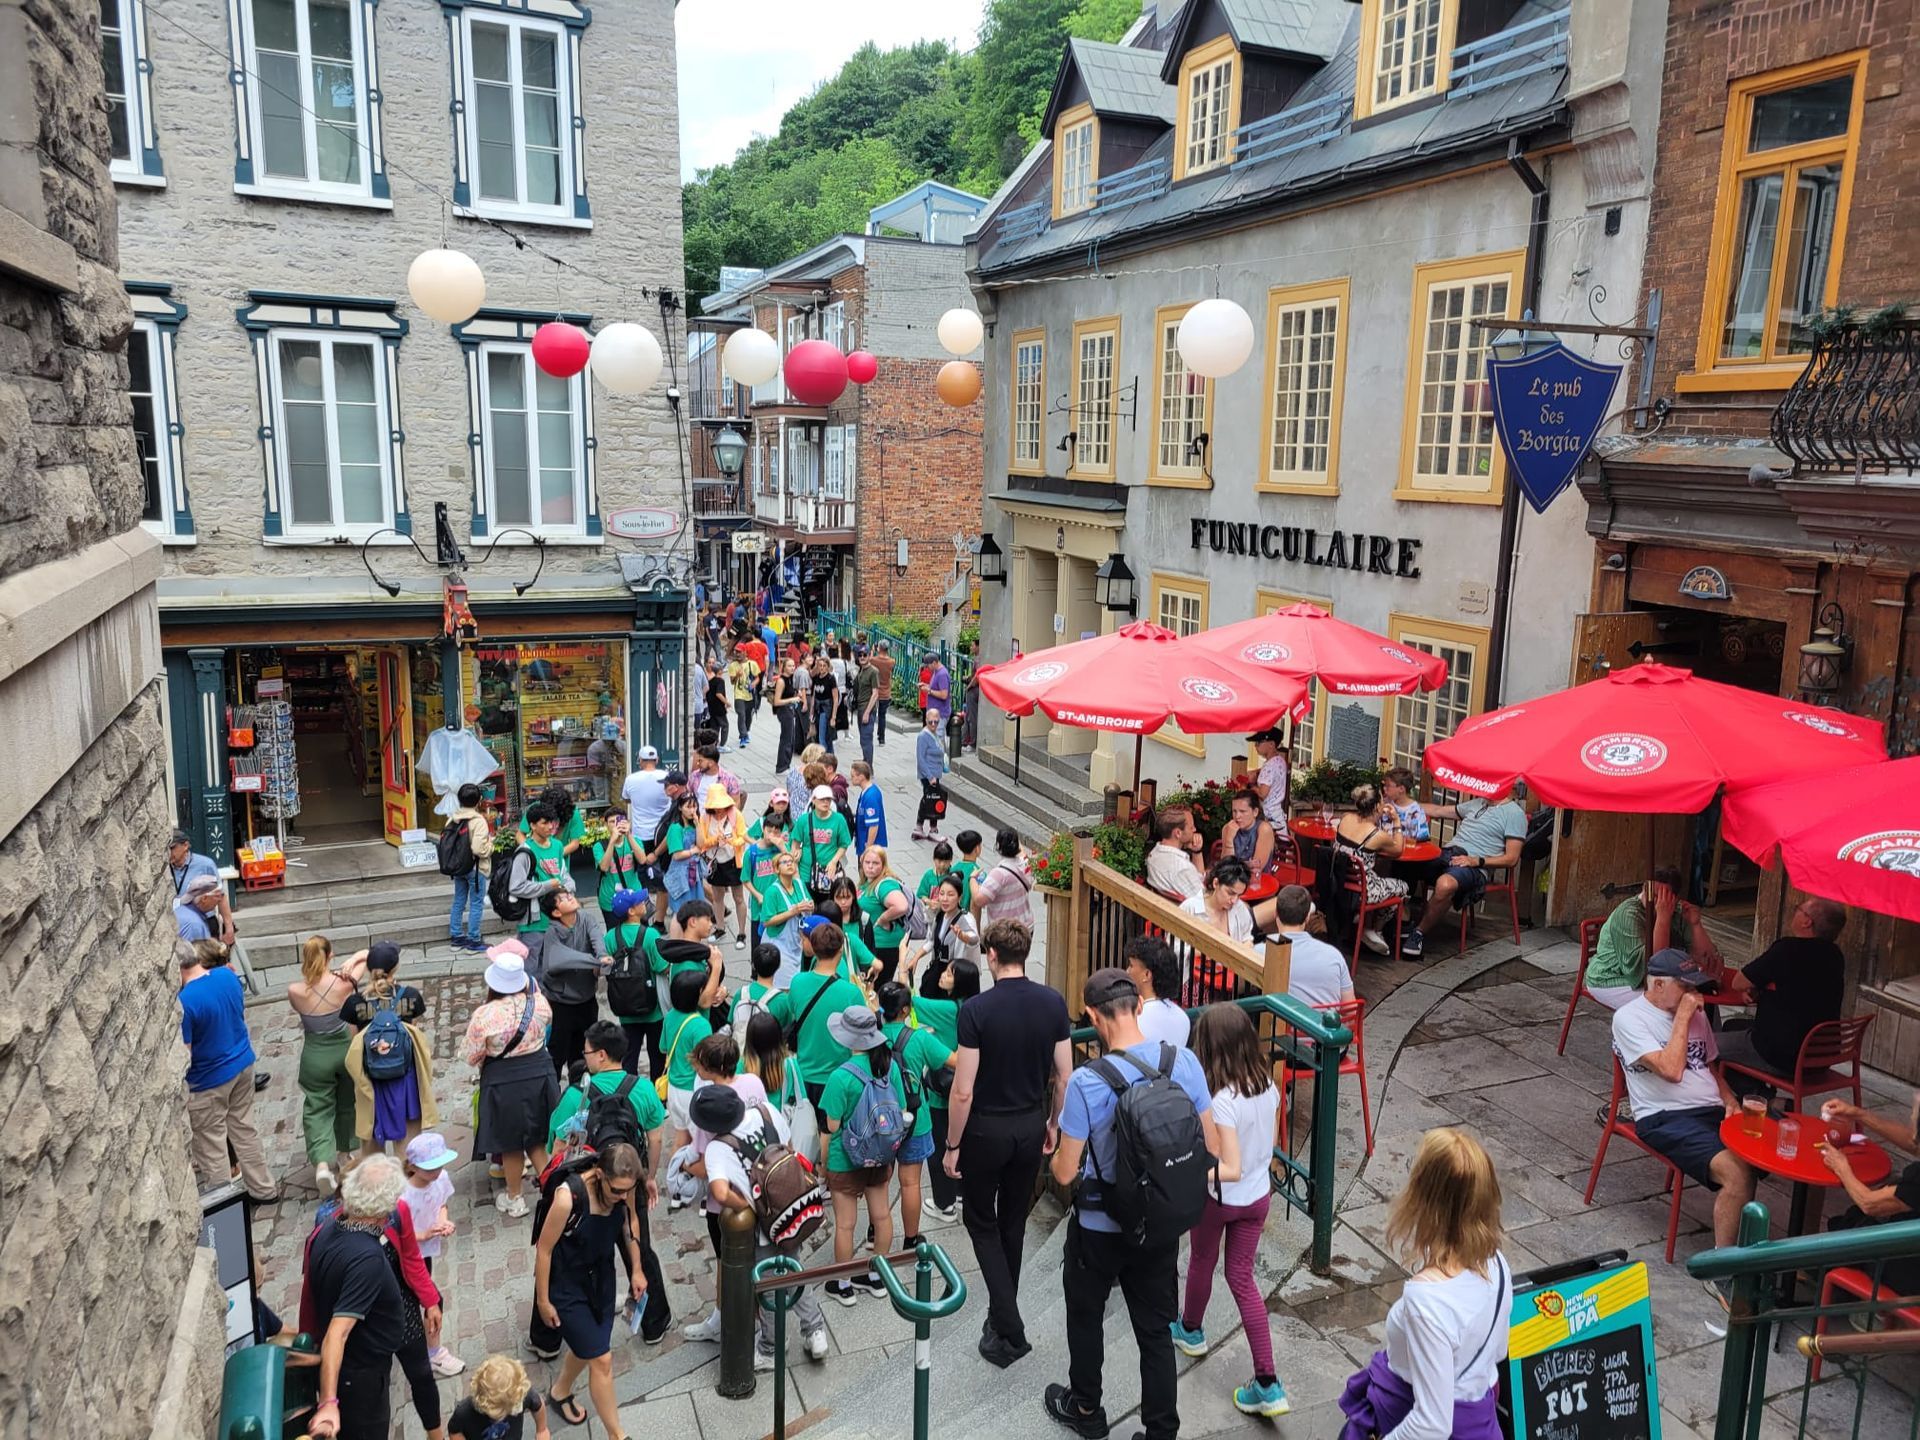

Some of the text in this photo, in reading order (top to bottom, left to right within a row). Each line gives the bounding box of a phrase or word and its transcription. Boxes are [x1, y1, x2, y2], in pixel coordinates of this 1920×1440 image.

[1527, 376, 1582, 400] Le pub
[1540, 403, 1564, 424] des
[1517, 428, 1581, 457] Borgia
[1190, 517, 1422, 579] FUNICULAIRE
[1697, 581, 1709, 592] 12
[1336, 682, 1402, 693] ST-AMBROISE
[1057, 710, 1144, 729] ST-AMBROISE
[1589, 736, 1660, 758] ST-AMBROISE
[1569, 1305, 1599, 1335] IPA
[1604, 1370, 1628, 1391] IPA
